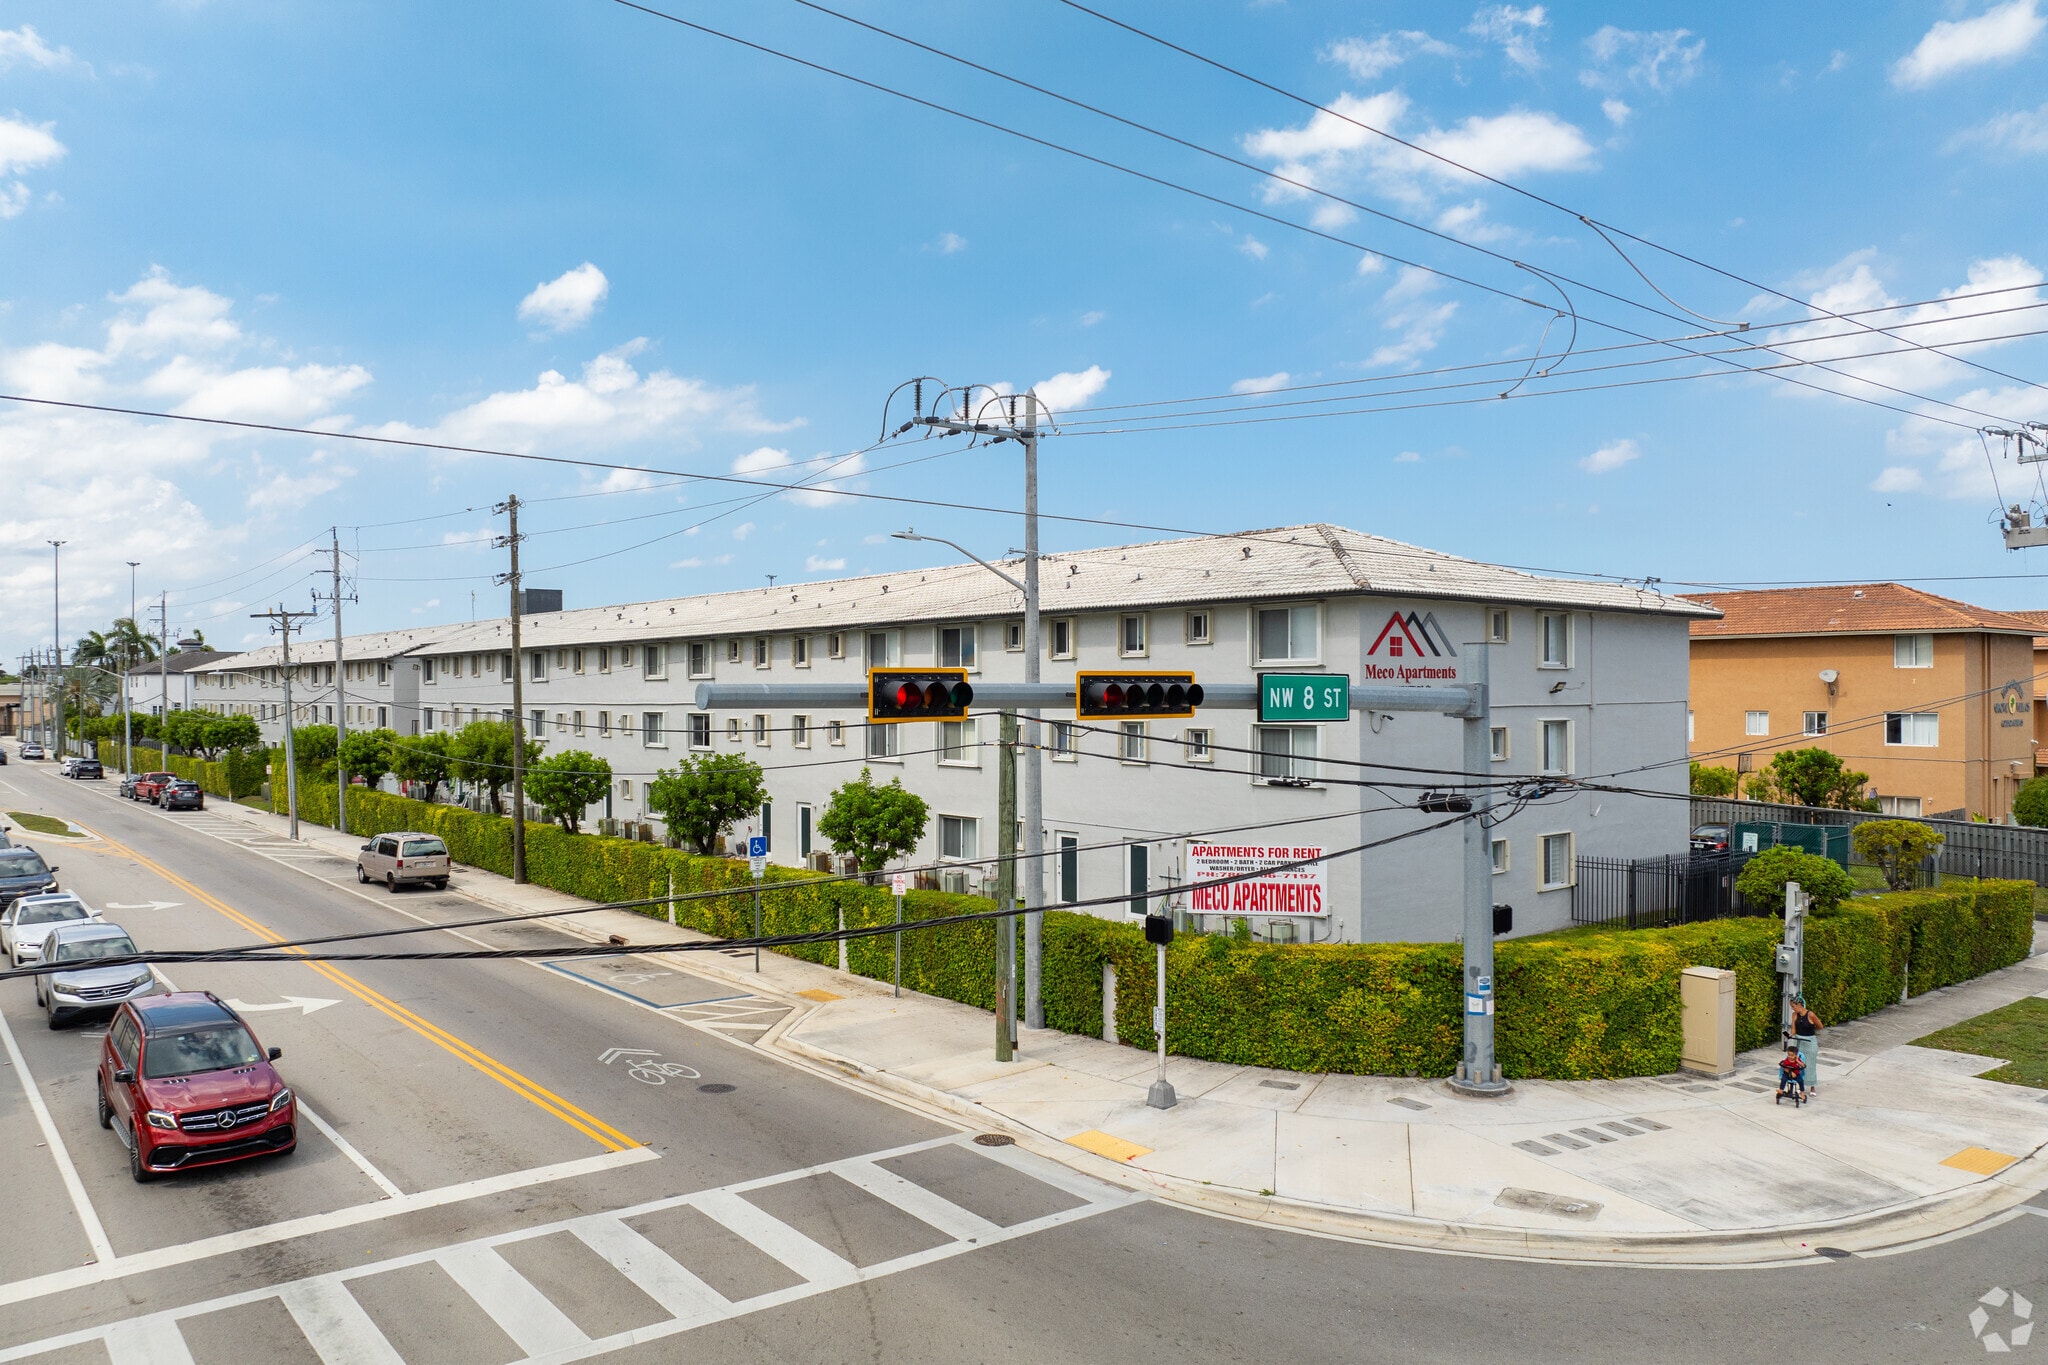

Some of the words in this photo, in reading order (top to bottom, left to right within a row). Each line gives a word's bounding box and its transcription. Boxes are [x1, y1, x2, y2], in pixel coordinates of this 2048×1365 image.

[1365, 664, 1394, 679] Meco
[1397, 664, 1456, 684] Apartments
[1270, 688, 1294, 708] NW
[1303, 686, 1314, 710] 8
[1324, 688, 1342, 708] ST
[1192, 846, 1264, 858] APARTMENTS
[1268, 847, 1289, 858] FOR
[1293, 848, 1322, 859] RENT
[1192, 881, 1230, 911] MECO
[1233, 883, 1322, 913] APARTMENTS
